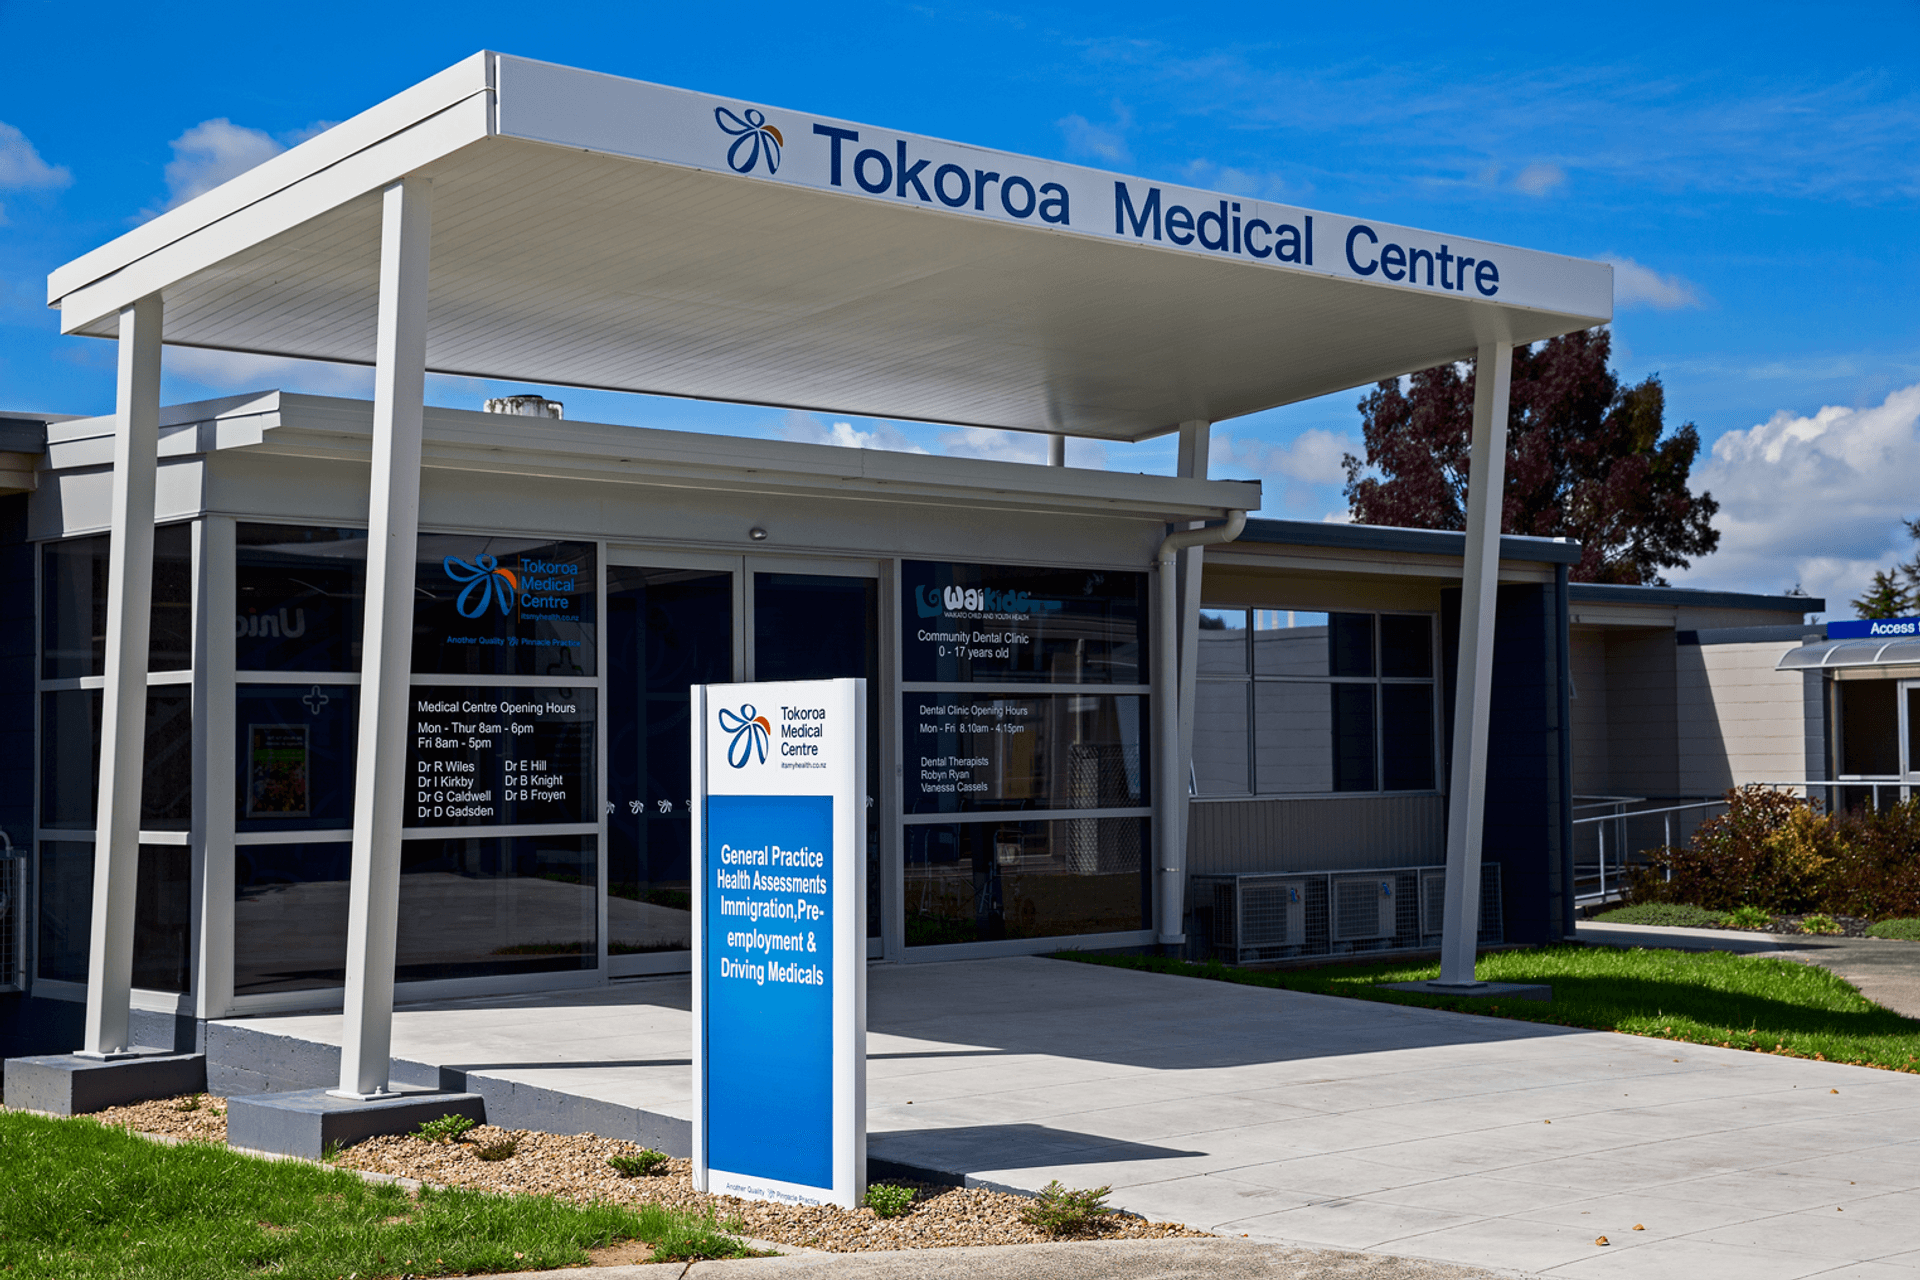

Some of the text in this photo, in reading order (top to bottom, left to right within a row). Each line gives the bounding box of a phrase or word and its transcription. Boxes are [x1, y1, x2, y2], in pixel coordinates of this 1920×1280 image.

[813, 123, 1499, 296] Tokoroa Medical Centre
[521, 558, 578, 575] Tokoroa
[521, 576, 575, 592] Medical
[521, 593, 569, 609] Centre
[944, 611, 967, 619] WAIKATO
[1870, 622, 1915, 635] Access
[447, 636, 581, 647] Another Quality Pinnacle Practice
[918, 630, 1029, 645] Community Dental Clinic
[939, 646, 945, 657] 0
[954, 647, 964, 657] 17
[967, 649, 993, 660] years
[995, 648, 1009, 658] old
[418, 701, 576, 716] Medical Centre Opening Hours
[781, 706, 826, 720] Tokoroa
[920, 705, 1028, 717] Dental Clinic Opening Hours
[418, 722, 441, 733] Mon
[452, 722, 476, 733] Thur
[478, 722, 501, 733] 8am
[511, 722, 534, 736] 6pm
[781, 723, 823, 738] Medical
[920, 723, 938, 733] Mon
[945, 723, 956, 733] Fri
[959, 723, 989, 733] 8.10am
[996, 723, 1024, 734] 4.15pm
[418, 737, 432, 748] Fri
[435, 737, 458, 748] 8am
[468, 738, 491, 750] 5pm
[781, 742, 818, 756] Centre
[418, 761, 475, 772] Dr R Wiles
[505, 760, 547, 771] Dr E Hill
[921, 756, 989, 768] Dental Therapists
[418, 776, 431, 787] Dr
[440, 776, 474, 789] Kirkby
[505, 775, 563, 788] Dr B Knight
[921, 770, 970, 781] Robyn Ryan
[921, 782, 988, 793] Vanessa Cassels
[418, 790, 491, 802] Dr G Caldwell
[505, 789, 566, 803] Dr B Froyen
[418, 806, 493, 818] Dr D Gadsden
[721, 844, 823, 868] General Practice
[717, 869, 827, 895] Health Assessments
[727, 928, 817, 954] employment &
[721, 957, 824, 986] Driving Medicals
[726, 1182, 820, 1205] Another Quality Pinnacle Practice
